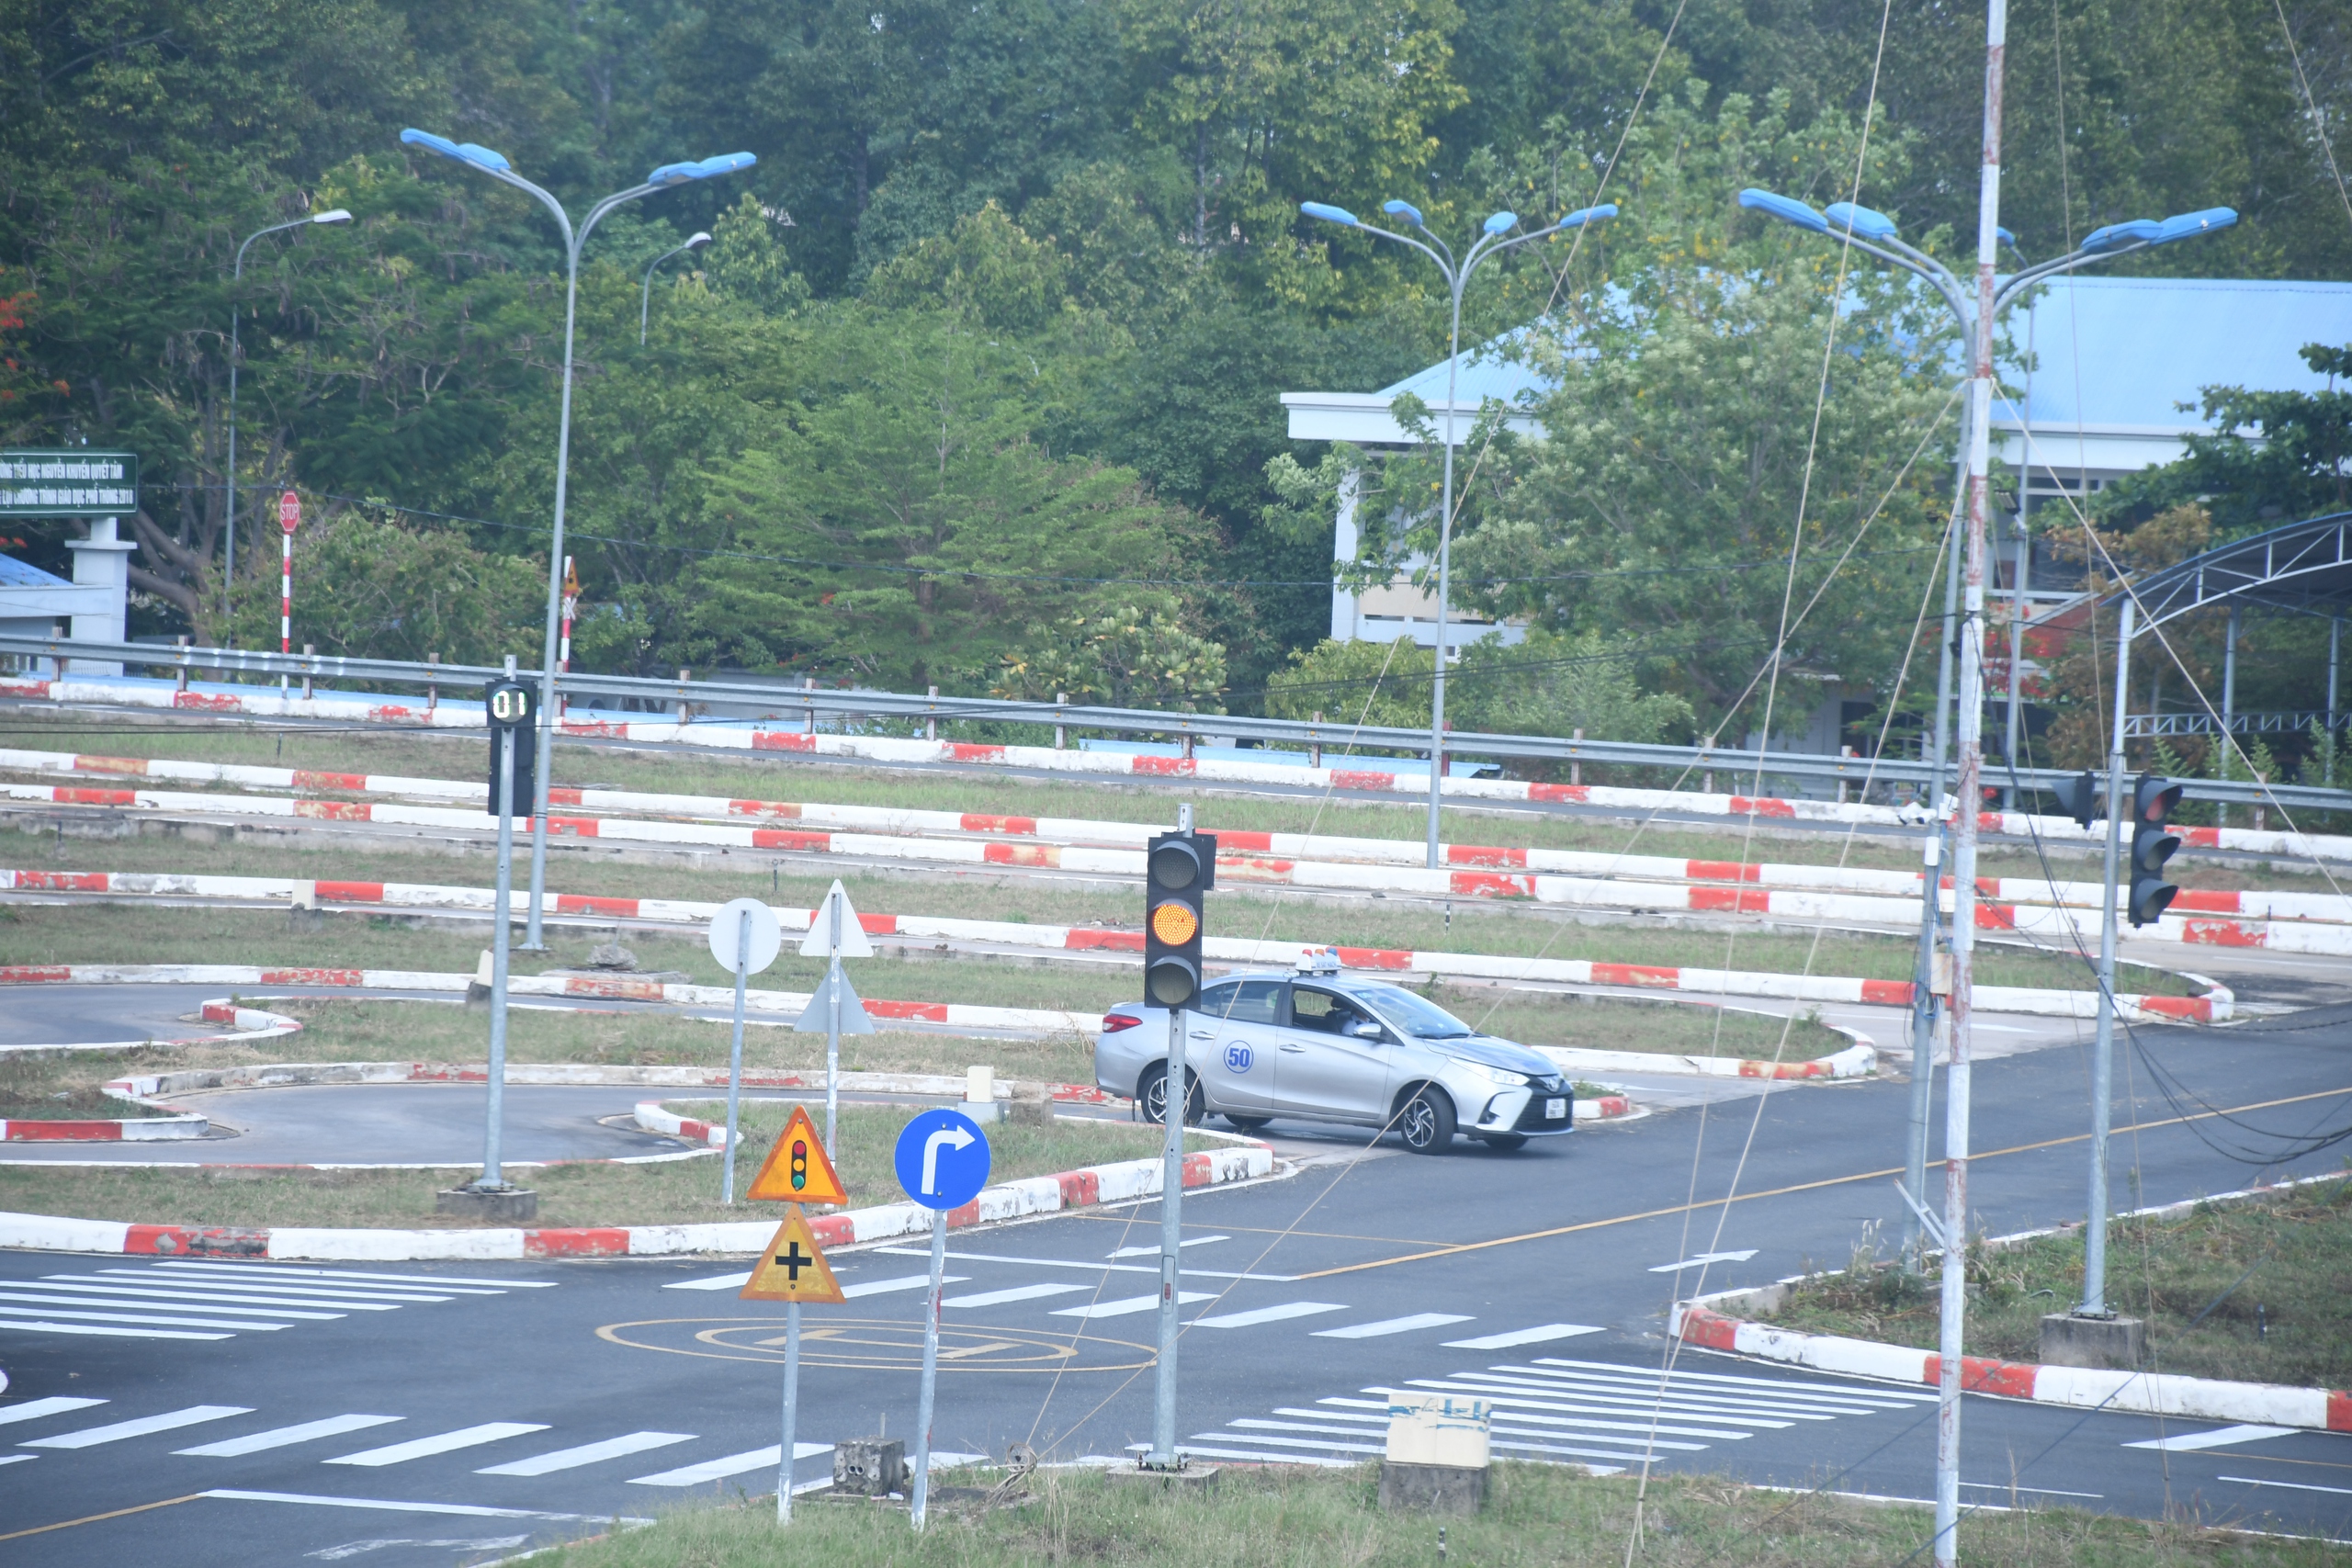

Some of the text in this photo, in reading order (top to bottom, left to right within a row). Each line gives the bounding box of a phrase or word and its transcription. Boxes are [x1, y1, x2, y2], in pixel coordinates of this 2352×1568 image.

[28, 462, 40, 482] HỌC
[280, 503, 299, 521] STOP
[492, 690, 526, 718] 01
[1228, 1047, 1250, 1067] 50
